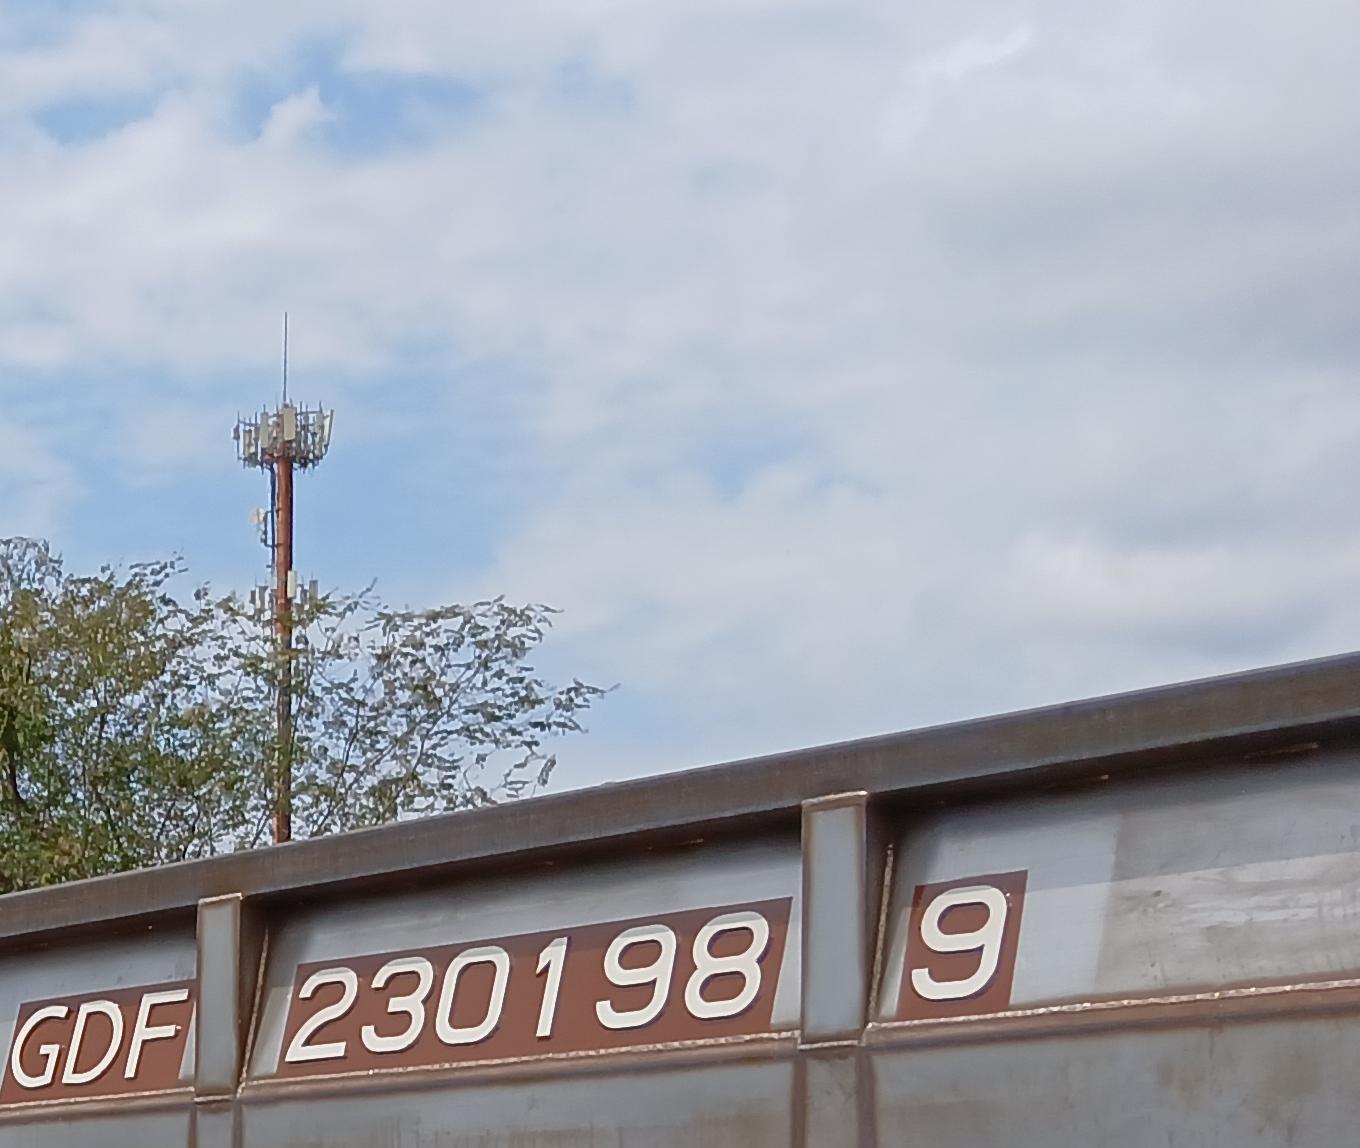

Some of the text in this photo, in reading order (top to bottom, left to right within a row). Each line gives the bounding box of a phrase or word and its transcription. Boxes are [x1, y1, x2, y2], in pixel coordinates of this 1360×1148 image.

[8, 885, 1010, 1089] GDF 230198 9
